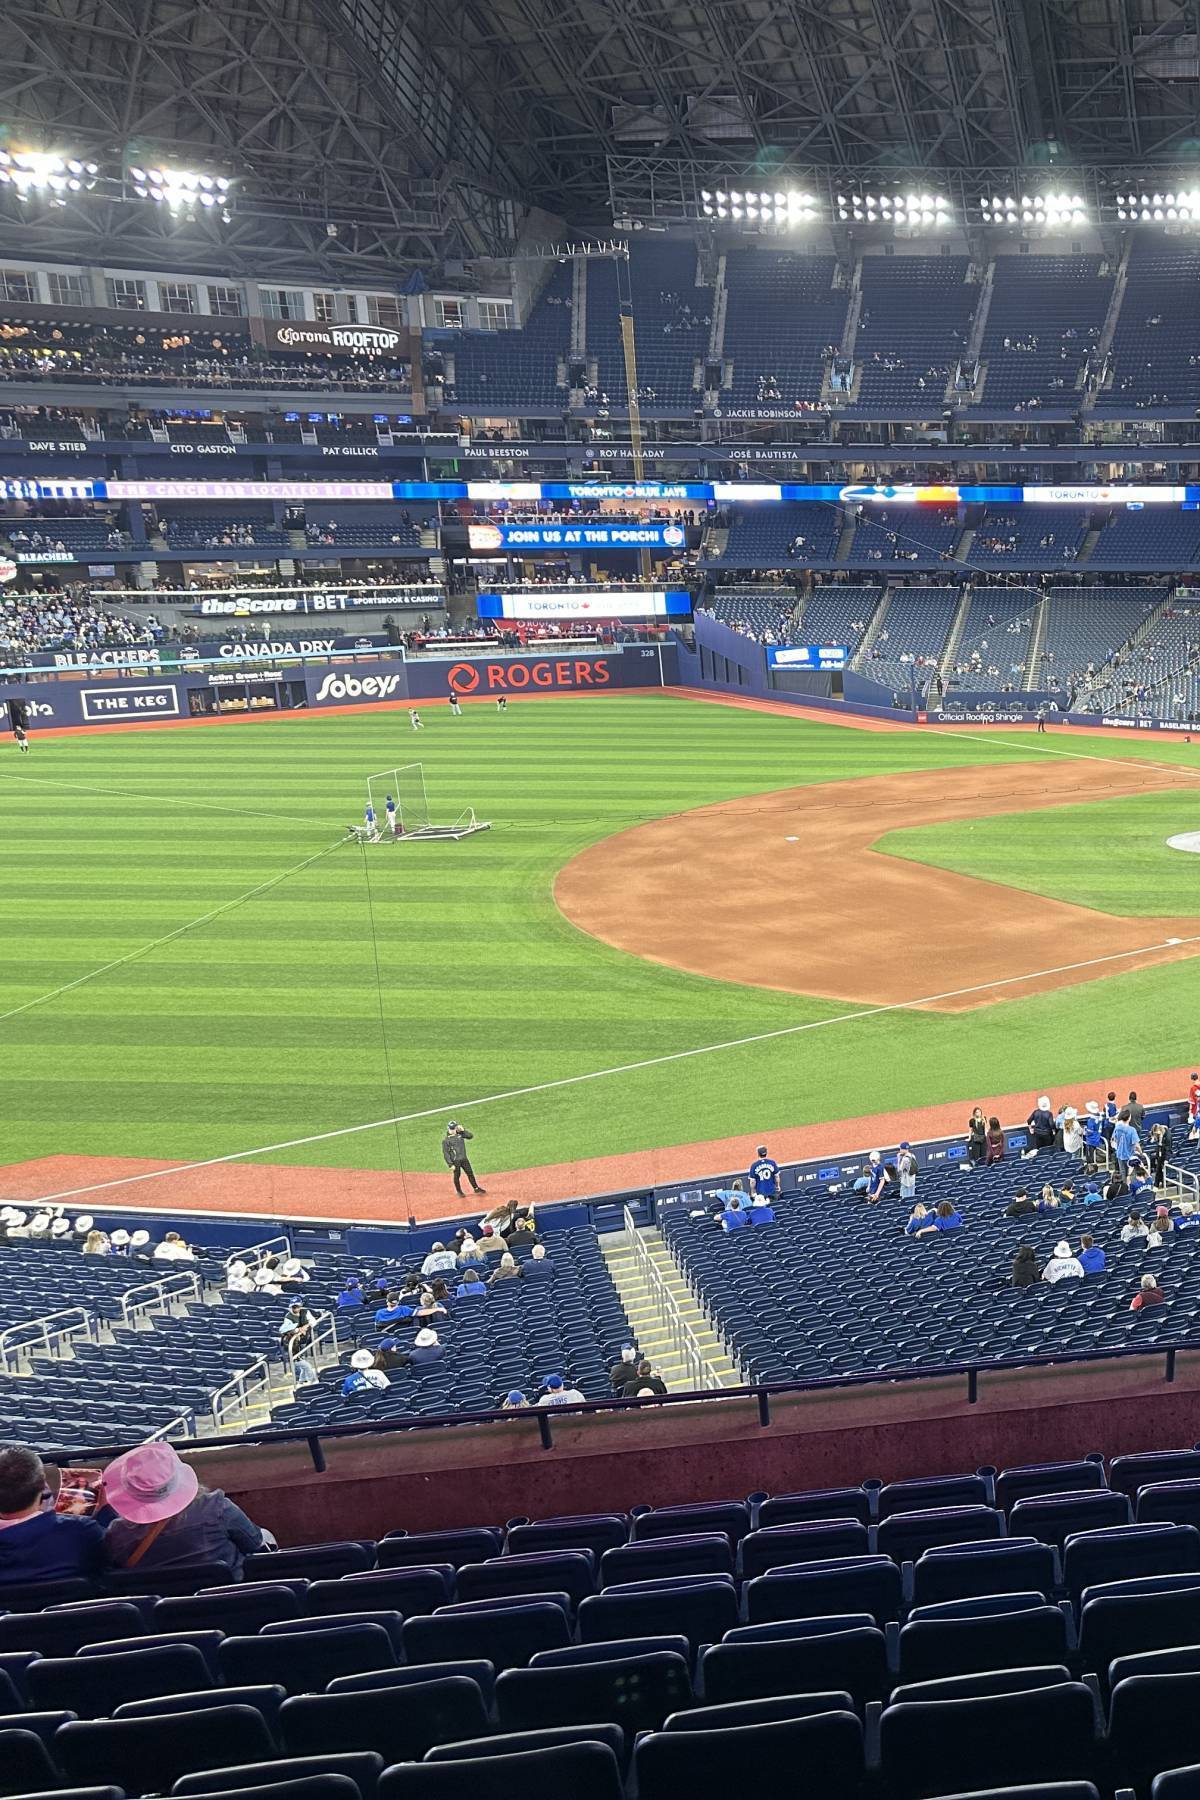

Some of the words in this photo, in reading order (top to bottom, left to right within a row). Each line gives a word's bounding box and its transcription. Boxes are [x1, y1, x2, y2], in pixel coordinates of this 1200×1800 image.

[277, 327, 331, 345] Corona
[333, 330, 399, 348] ROOFTOP
[353, 347, 382, 355] PATIO
[726, 410, 755, 418] JACKIE
[757, 410, 802, 418] ROBINSON
[29, 442, 56, 450] DAVE
[59, 443, 87, 451] STIEB
[170, 445, 194, 453] CITO
[197, 446, 237, 454] GASTON
[322, 447, 340, 455] PAT
[342, 448, 378, 456] GILLICK
[465, 449, 488, 457] PAUL
[489, 449, 529, 457] BEESTON
[600, 450, 618, 458] ROY
[620, 450, 665, 458] HALLADAY
[729, 449, 751, 459] JOSÉ
[755, 451, 798, 459] BAUTISTA
[569, 486, 624, 497] TORONTO
[635, 486, 661, 497] BLUE
[662, 486, 687, 497] JAYS
[1050, 491, 1099, 499] TORONTO
[507, 532, 540, 543] JOIN
[543, 532, 562, 542] US
[564, 532, 581, 542] AT
[584, 531, 609, 542] THE
[18, 552, 74, 561] BLEACHERS
[201, 597, 297, 614] theScore
[313, 594, 348, 610] BET
[353, 597, 403, 605] SPORTSBOOK
[411, 595, 439, 603] CASINO
[528, 602, 580, 611] TORONTO
[219, 640, 299, 658] CANADA
[640, 649, 655, 657] 328
[487, 660, 610, 688] ROGERS
[316, 672, 400, 701] Sobeys
[93, 697, 129, 709] THE
[133, 695, 167, 707] KEG
[938, 713, 965, 721] Official
[995, 713, 1023, 722] Shingle
[1140, 720, 1152, 728] BET
[1159, 722, 1191, 730] BASELINE
[758, 1169, 771, 1181] 10
